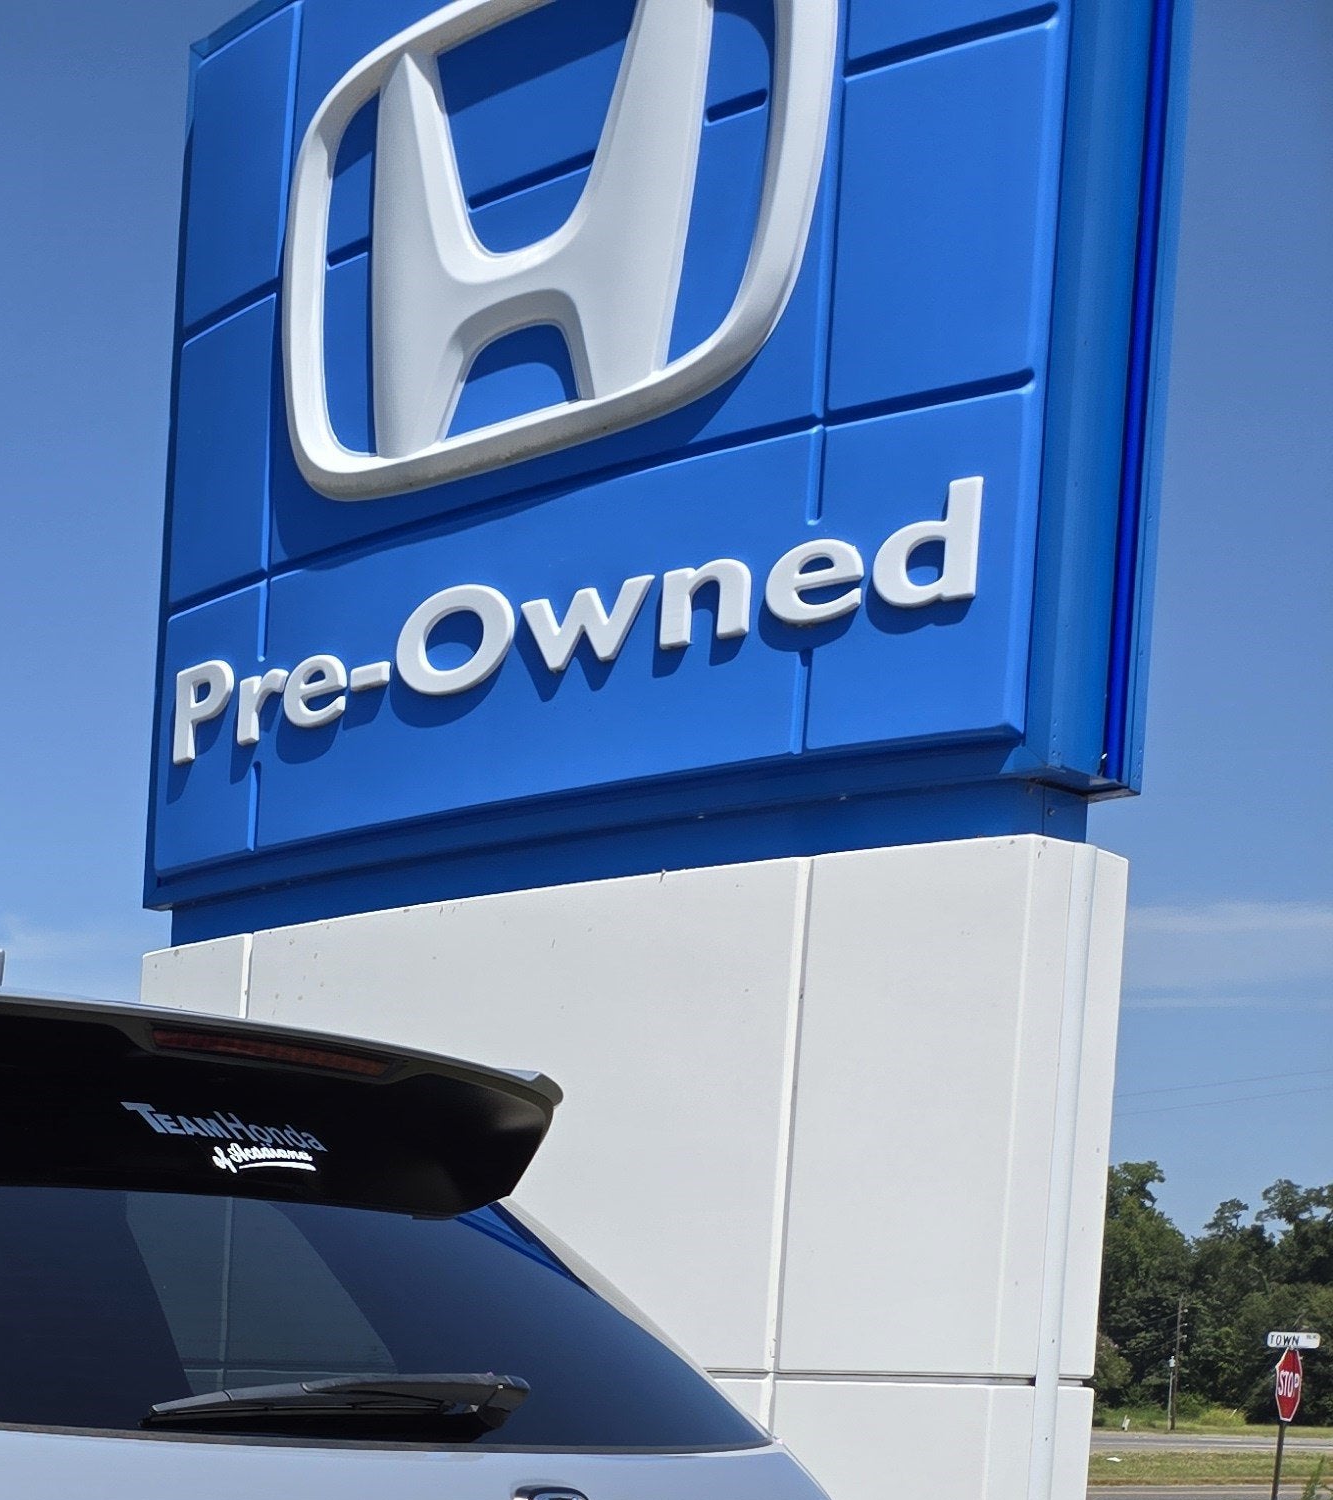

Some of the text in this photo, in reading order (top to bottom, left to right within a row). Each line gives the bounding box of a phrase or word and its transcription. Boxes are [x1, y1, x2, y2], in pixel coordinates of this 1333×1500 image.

[172, 475, 985, 764] Pre-Owned
[1270, 1334, 1300, 1346] TOWN
[1277, 1369, 1300, 1398] STOP
